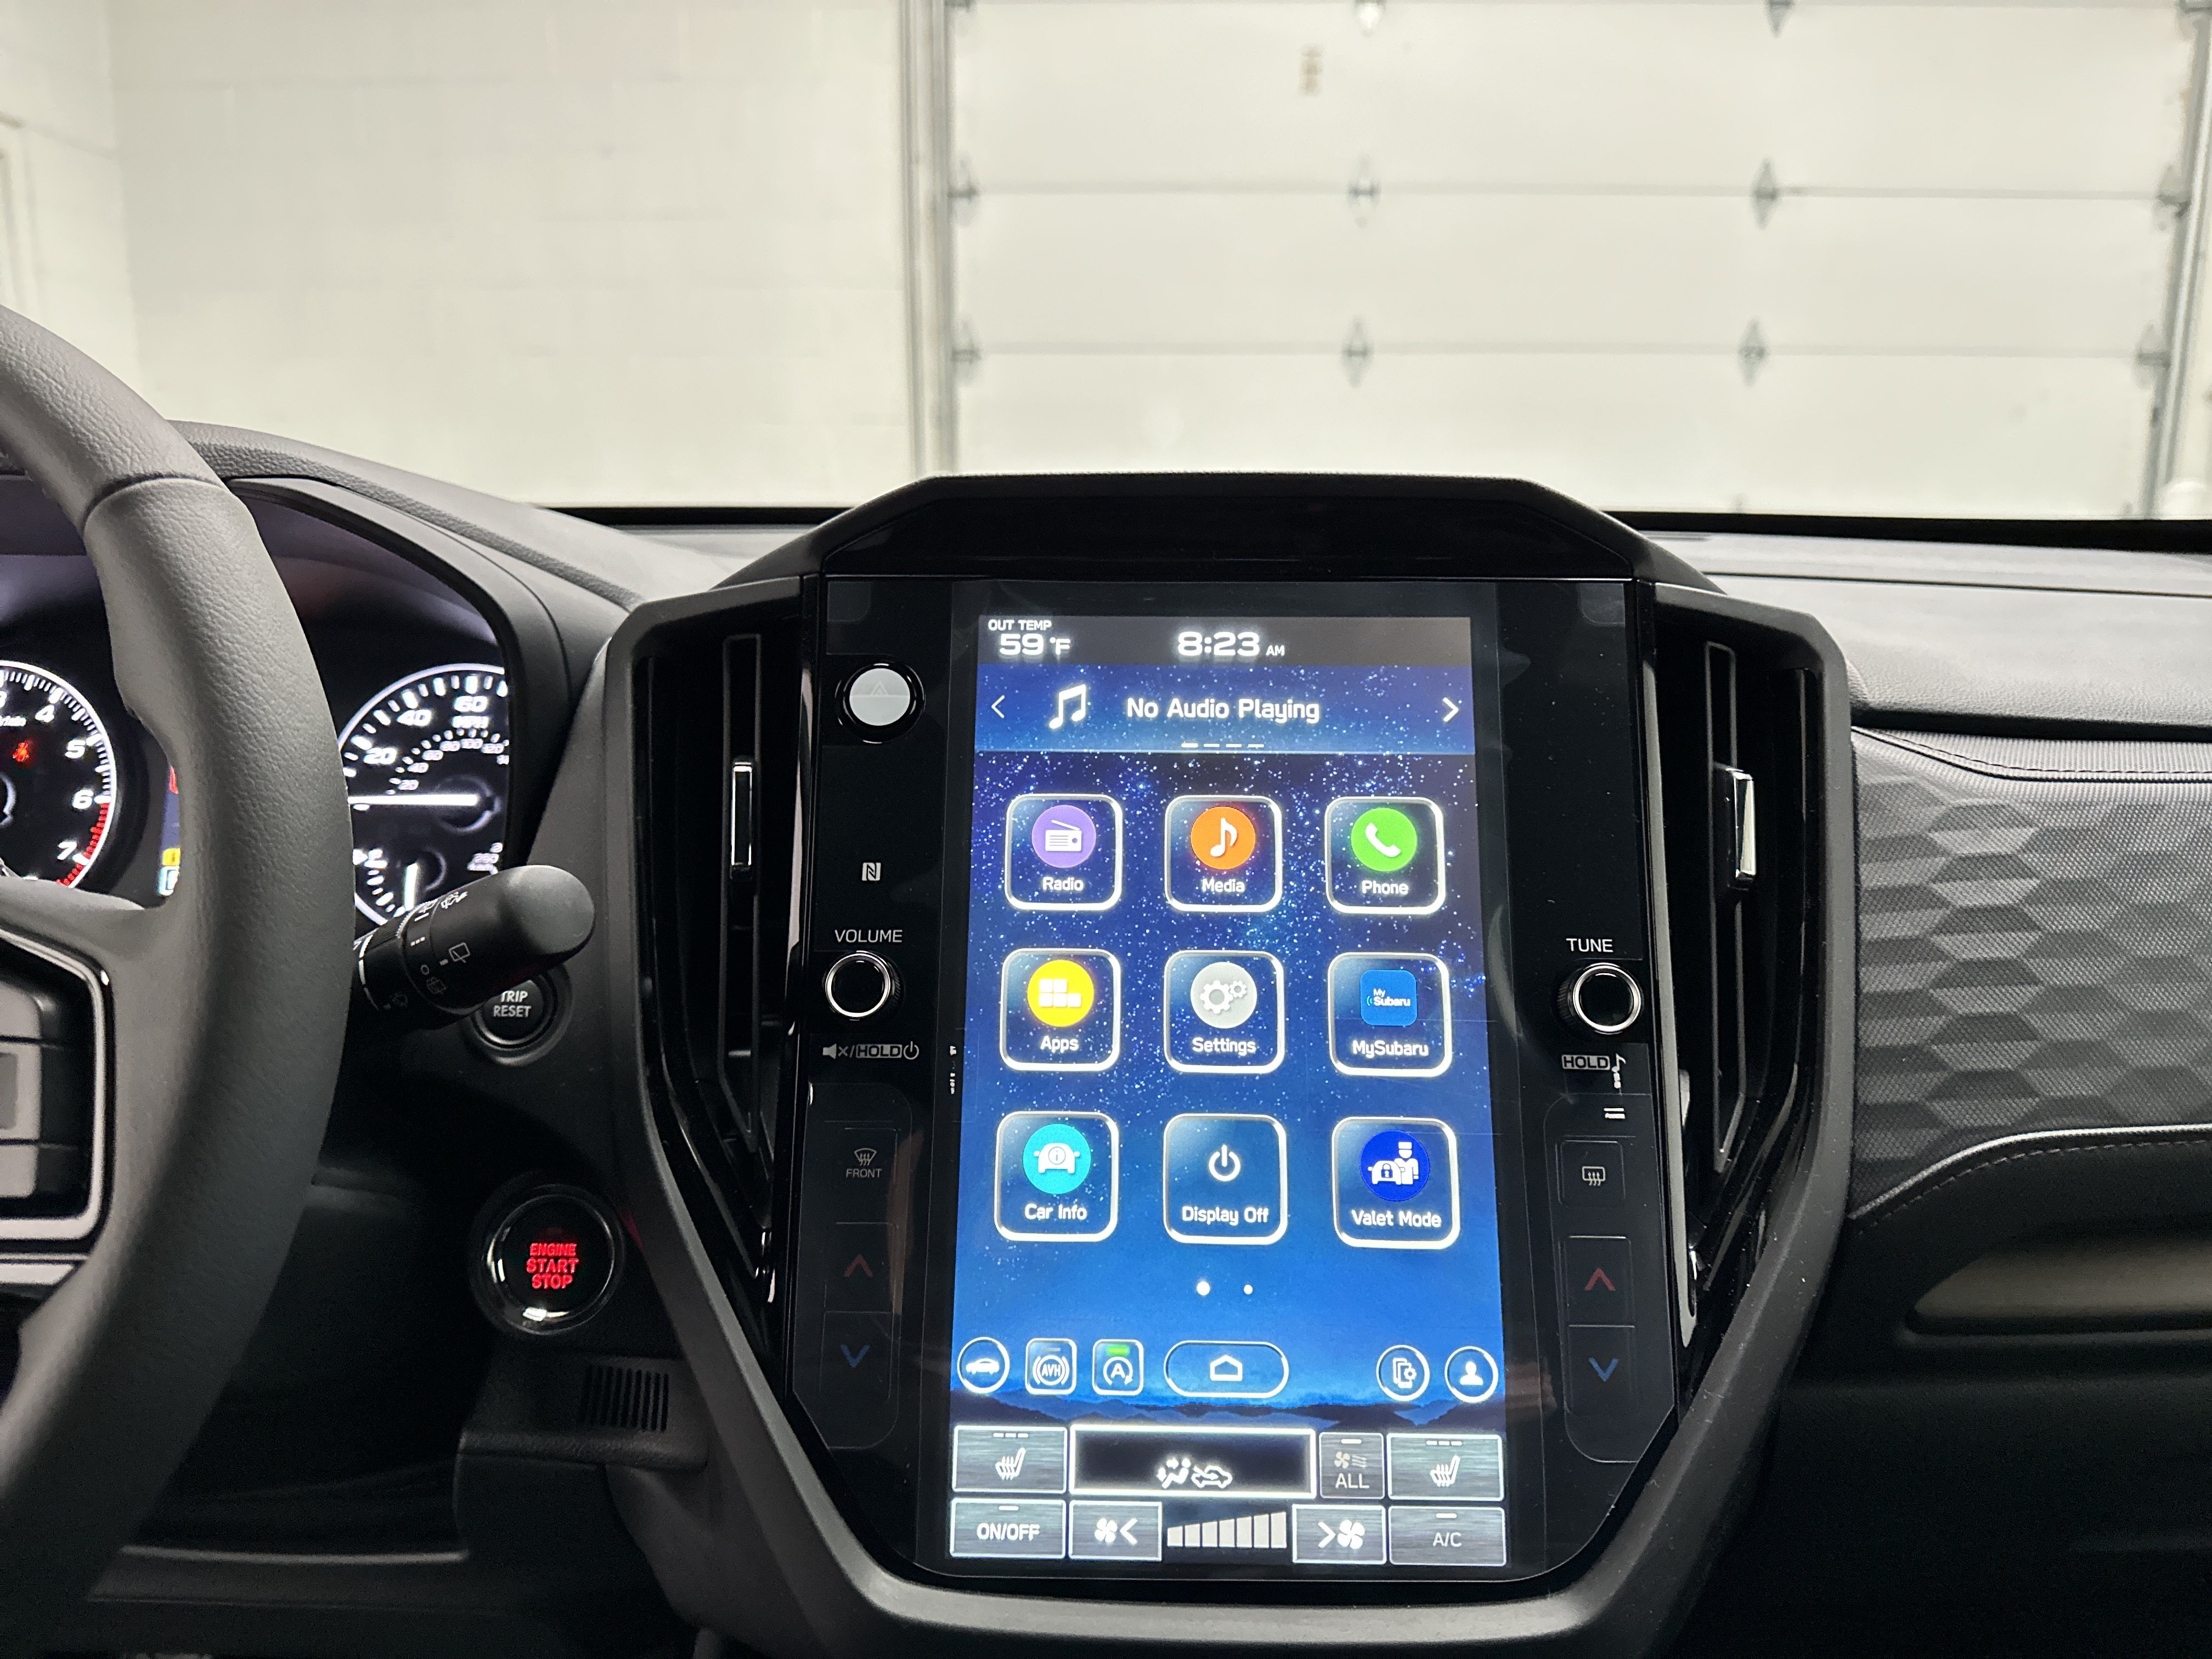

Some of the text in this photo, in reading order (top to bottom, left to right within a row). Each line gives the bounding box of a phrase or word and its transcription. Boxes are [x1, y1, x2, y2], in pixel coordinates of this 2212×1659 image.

[988, 619, 1052, 631] OUT TEMP
[999, 633, 1044, 656] 59
[1178, 631, 1285, 657] 8:23 AM
[454, 695, 489, 714] 60
[1127, 697, 1320, 724] No Audio Playing
[35, 704, 55, 723] 4
[396, 709, 432, 727] 40
[64, 738, 86, 759] 5
[363, 747, 398, 765] 20
[72, 789, 94, 810] 6
[57, 841, 78, 861] 7
[1042, 876, 1084, 891] Radio
[1201, 876, 1245, 893] Media
[1362, 880, 1409, 895] Phone
[834, 929, 903, 943] VOLUME
[1566, 938, 1613, 952] TUNE
[501, 990, 528, 1002] TRIP
[1373, 988, 1385, 998] My
[1373, 997, 1411, 1007] Subaru
[493, 1005, 532, 1018] RESET
[1040, 1035, 1079, 1053] Apps
[1192, 1037, 1256, 1056] Settings
[1352, 1040, 1429, 1059] MySubaru
[1563, 1056, 1609, 1069] HOLD
[846, 1168, 882, 1178] FRONT
[1024, 1203, 1087, 1220] Car Info
[1182, 1206, 1269, 1226] Display Off
[1351, 1209, 1442, 1228] Valet Mode
[529, 1243, 577, 1256] ENGINE
[526, 1257, 579, 1273] START
[532, 1273, 573, 1289] STOP
[1041, 1362, 1061, 1378] AVH
[1335, 1472, 1370, 1489] ALL
[977, 1523, 1040, 1541] ON/OFF
[1432, 1532, 1463, 1548] A/C
